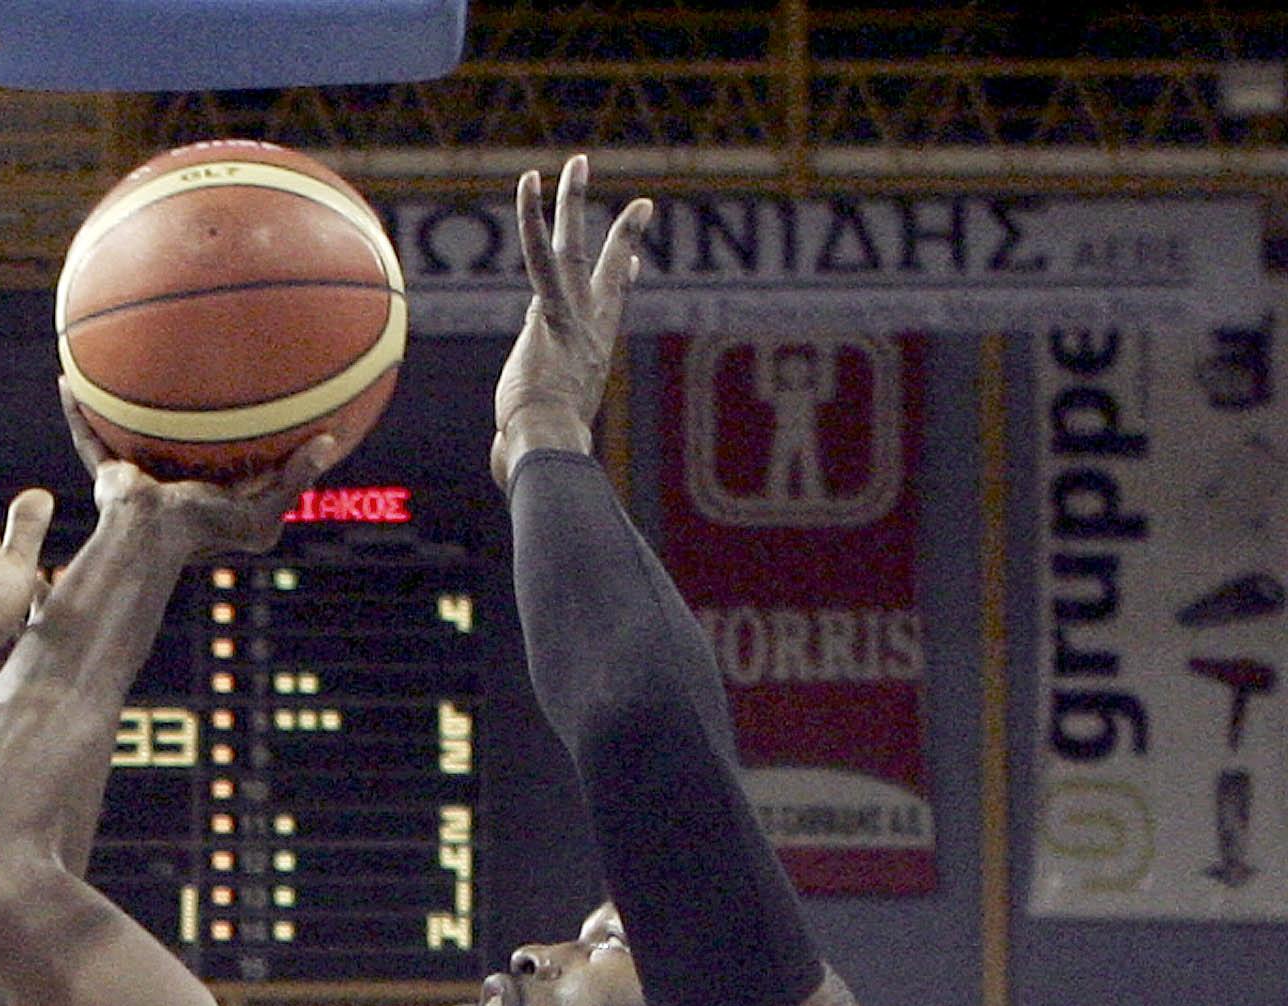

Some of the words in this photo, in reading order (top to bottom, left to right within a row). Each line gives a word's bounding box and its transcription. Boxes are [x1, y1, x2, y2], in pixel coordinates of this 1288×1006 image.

[1051, 327, 1150, 763] gruppe
[698, 607, 926, 685] ORRIS
[110, 706, 199, 768] 33
